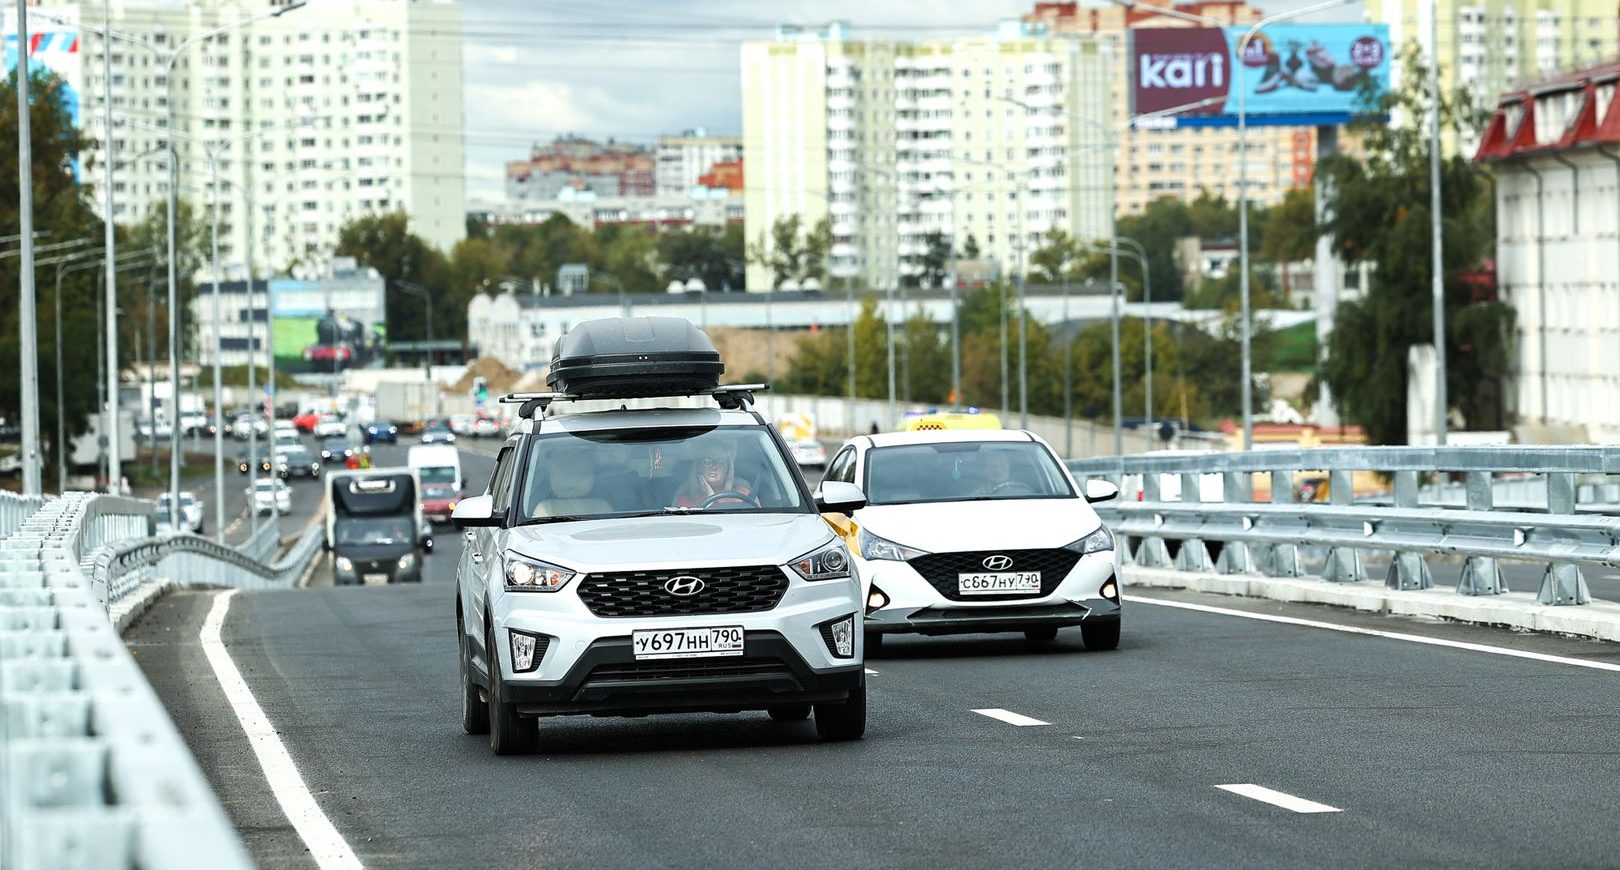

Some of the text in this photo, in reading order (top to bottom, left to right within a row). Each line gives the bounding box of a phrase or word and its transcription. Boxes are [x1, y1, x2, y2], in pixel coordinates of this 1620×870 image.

[1140, 53, 1223, 88] kari
[640, 629, 739, 651] У697НН 790
